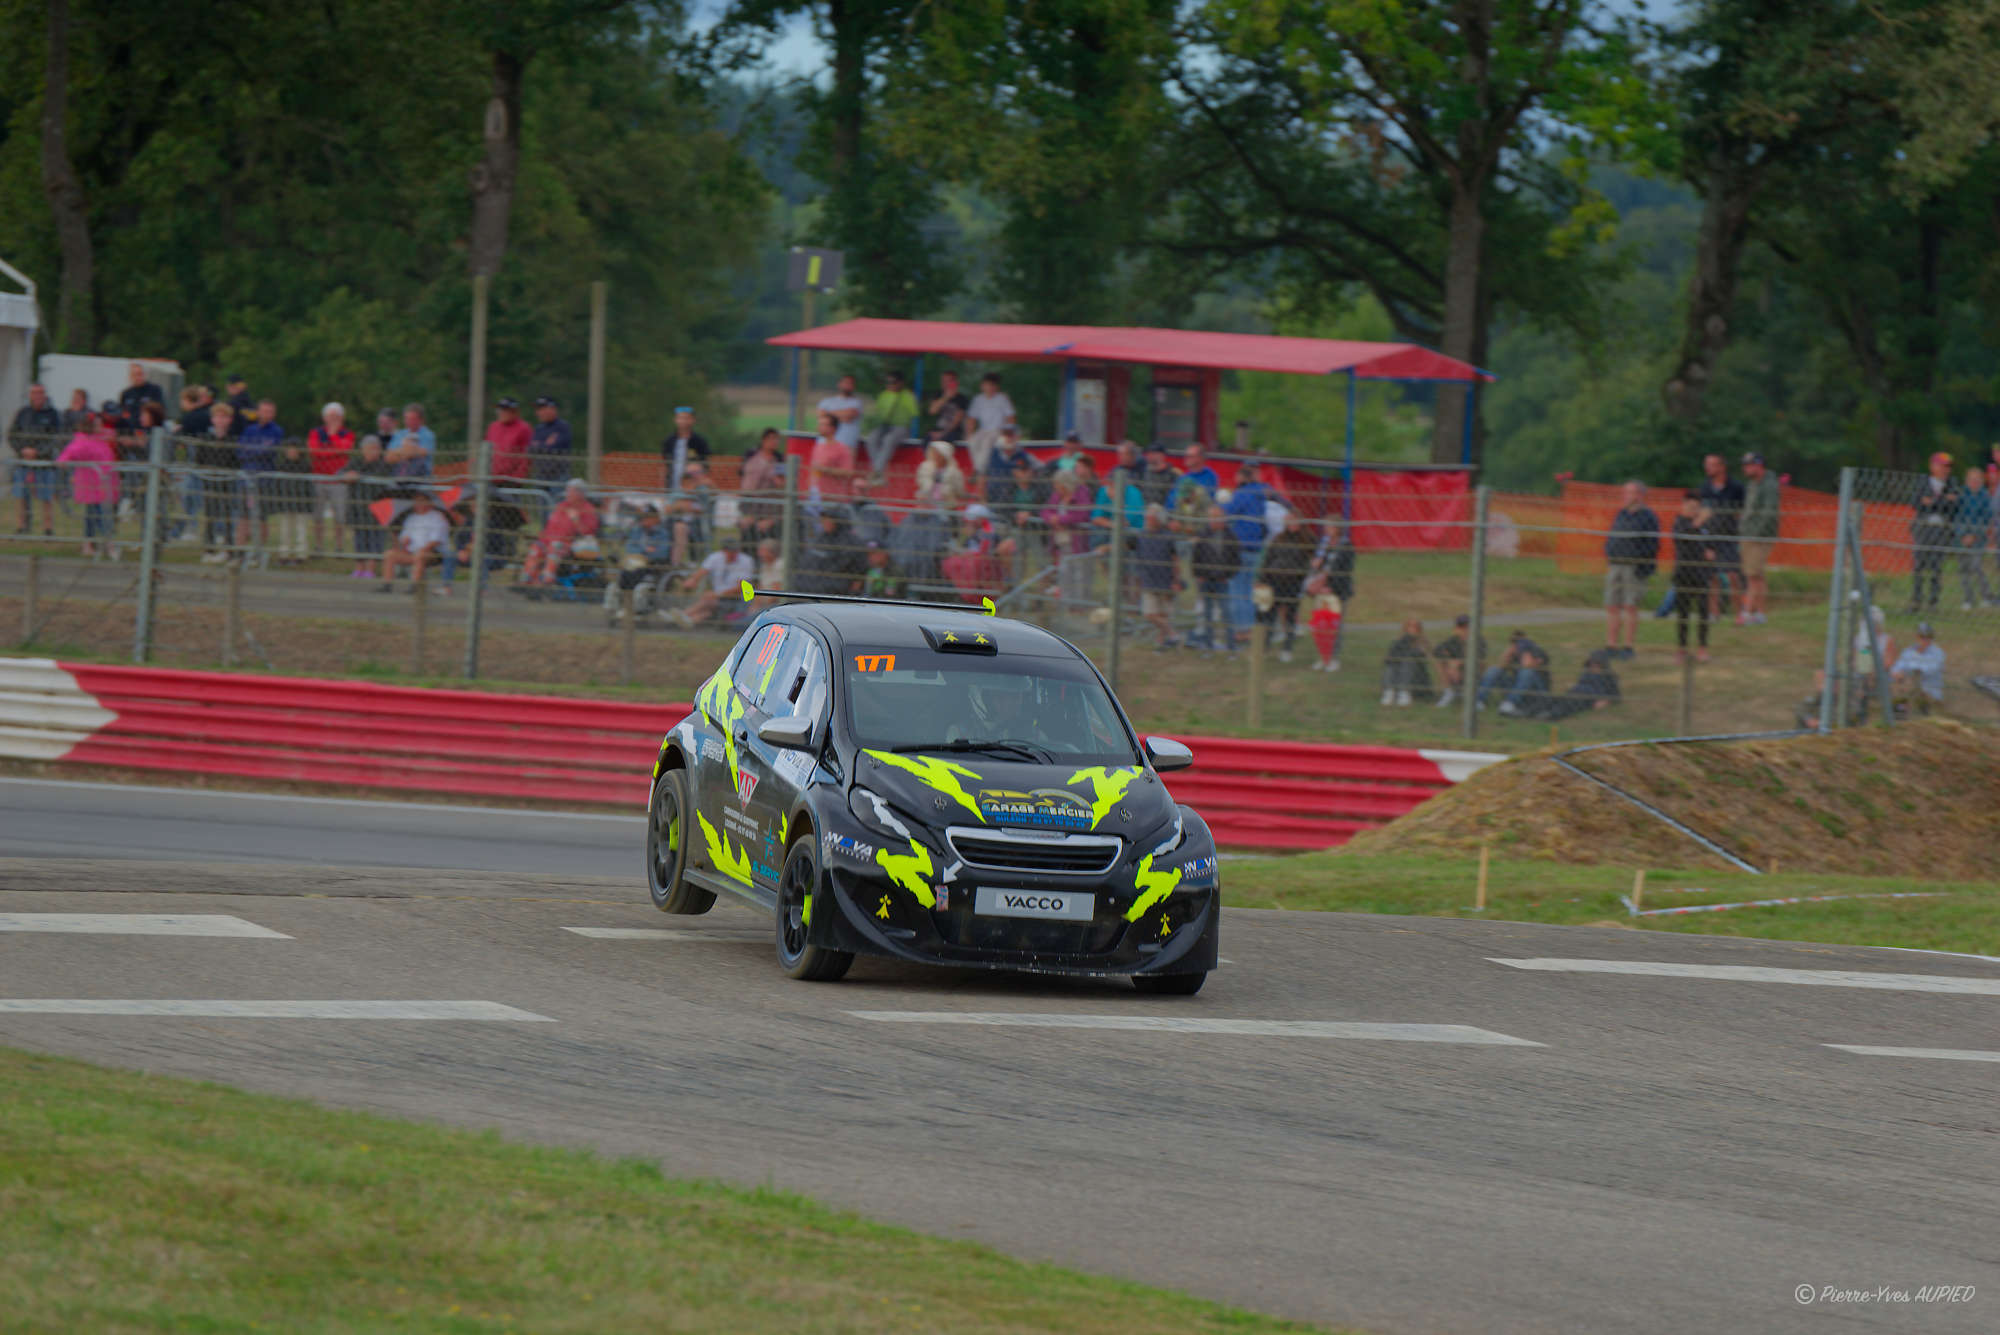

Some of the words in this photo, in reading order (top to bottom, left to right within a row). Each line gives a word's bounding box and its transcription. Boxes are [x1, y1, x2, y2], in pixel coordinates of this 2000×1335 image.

[854, 654, 896, 672] 177
[738, 778, 754, 803] AD
[982, 803, 1035, 814] GARAGE
[1039, 806, 1094, 818] MERCIER
[1004, 895, 1064, 911] YACCO
